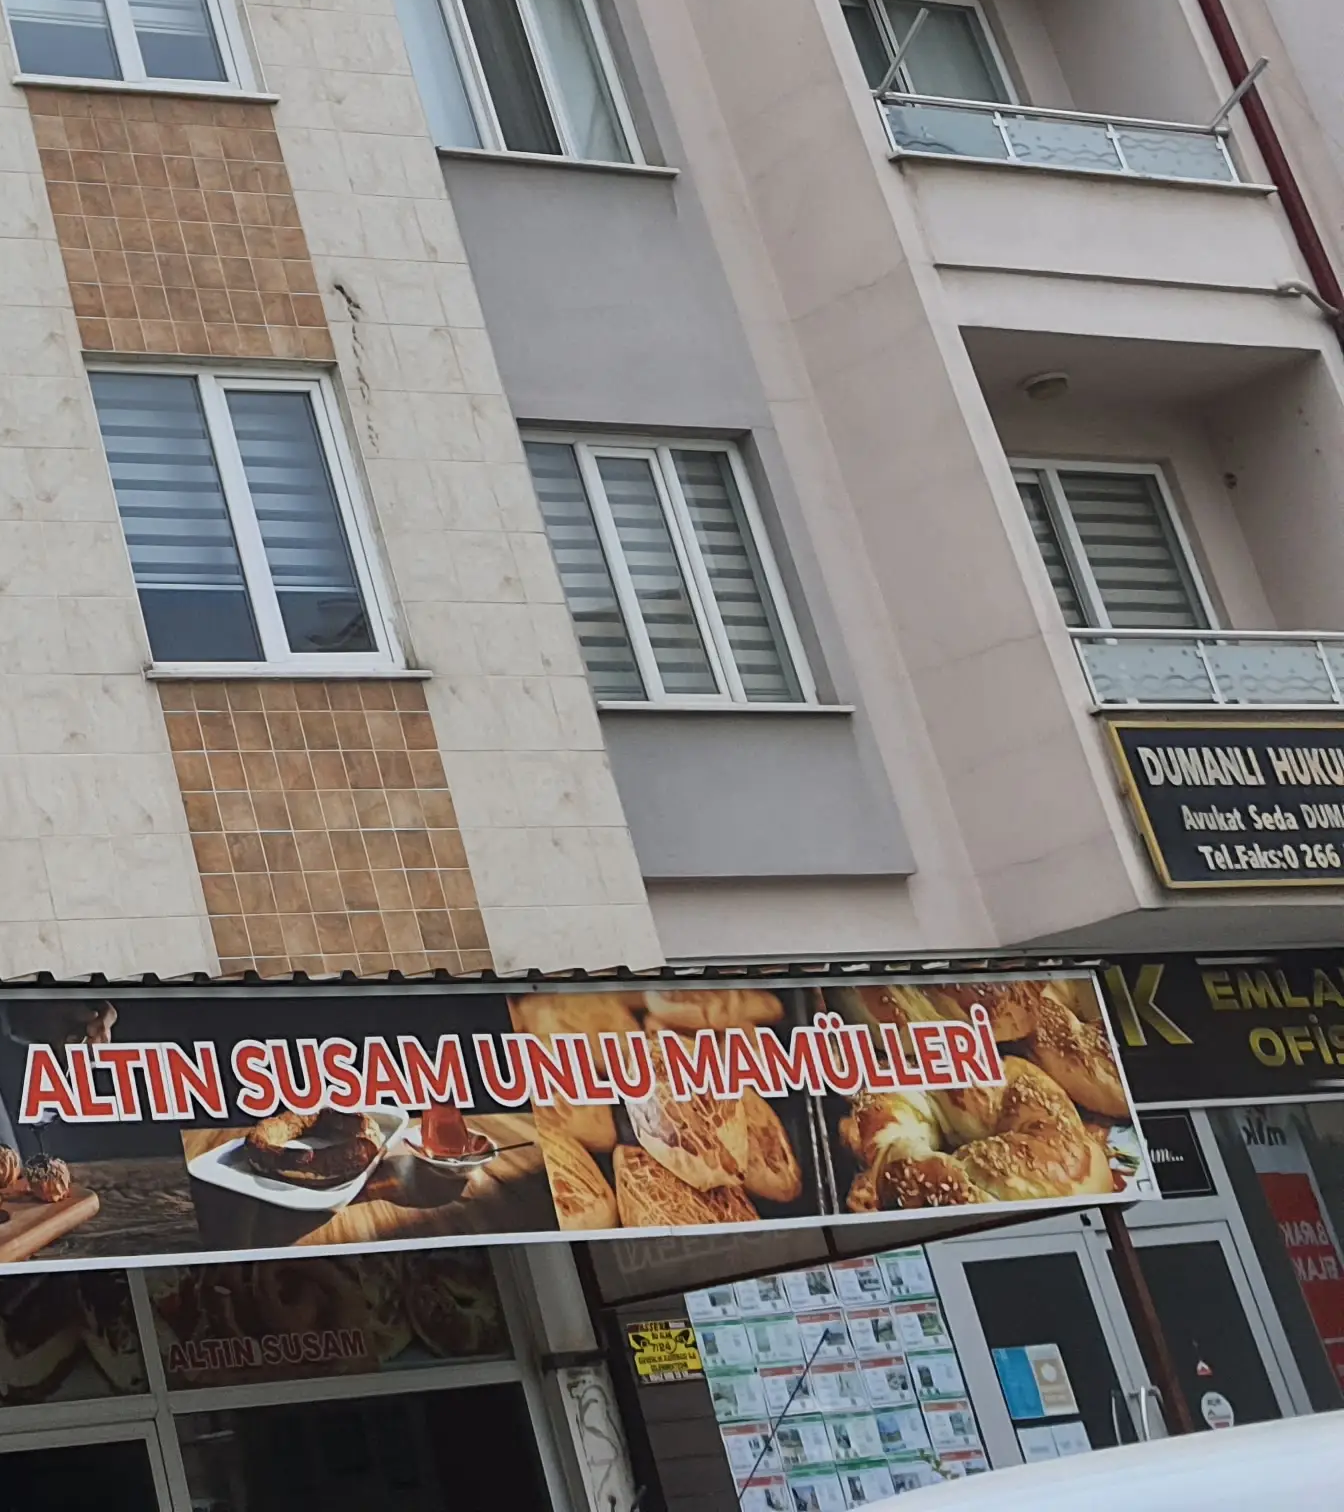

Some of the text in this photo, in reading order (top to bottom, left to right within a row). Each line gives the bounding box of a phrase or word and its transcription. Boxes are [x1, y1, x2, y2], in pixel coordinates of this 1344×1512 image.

[1136, 746, 1266, 786] DUMANLI
[1180, 803, 1344, 831] Avukat Seda DUM
[1299, 843, 1341, 869] 266
[1201, 967, 1344, 1011] EMLA
[18, 1002, 1008, 1125] ALTIN SUSAM UNLU MAMÜLLERİ
[167, 1329, 368, 1373] ALTIN SUSAM
